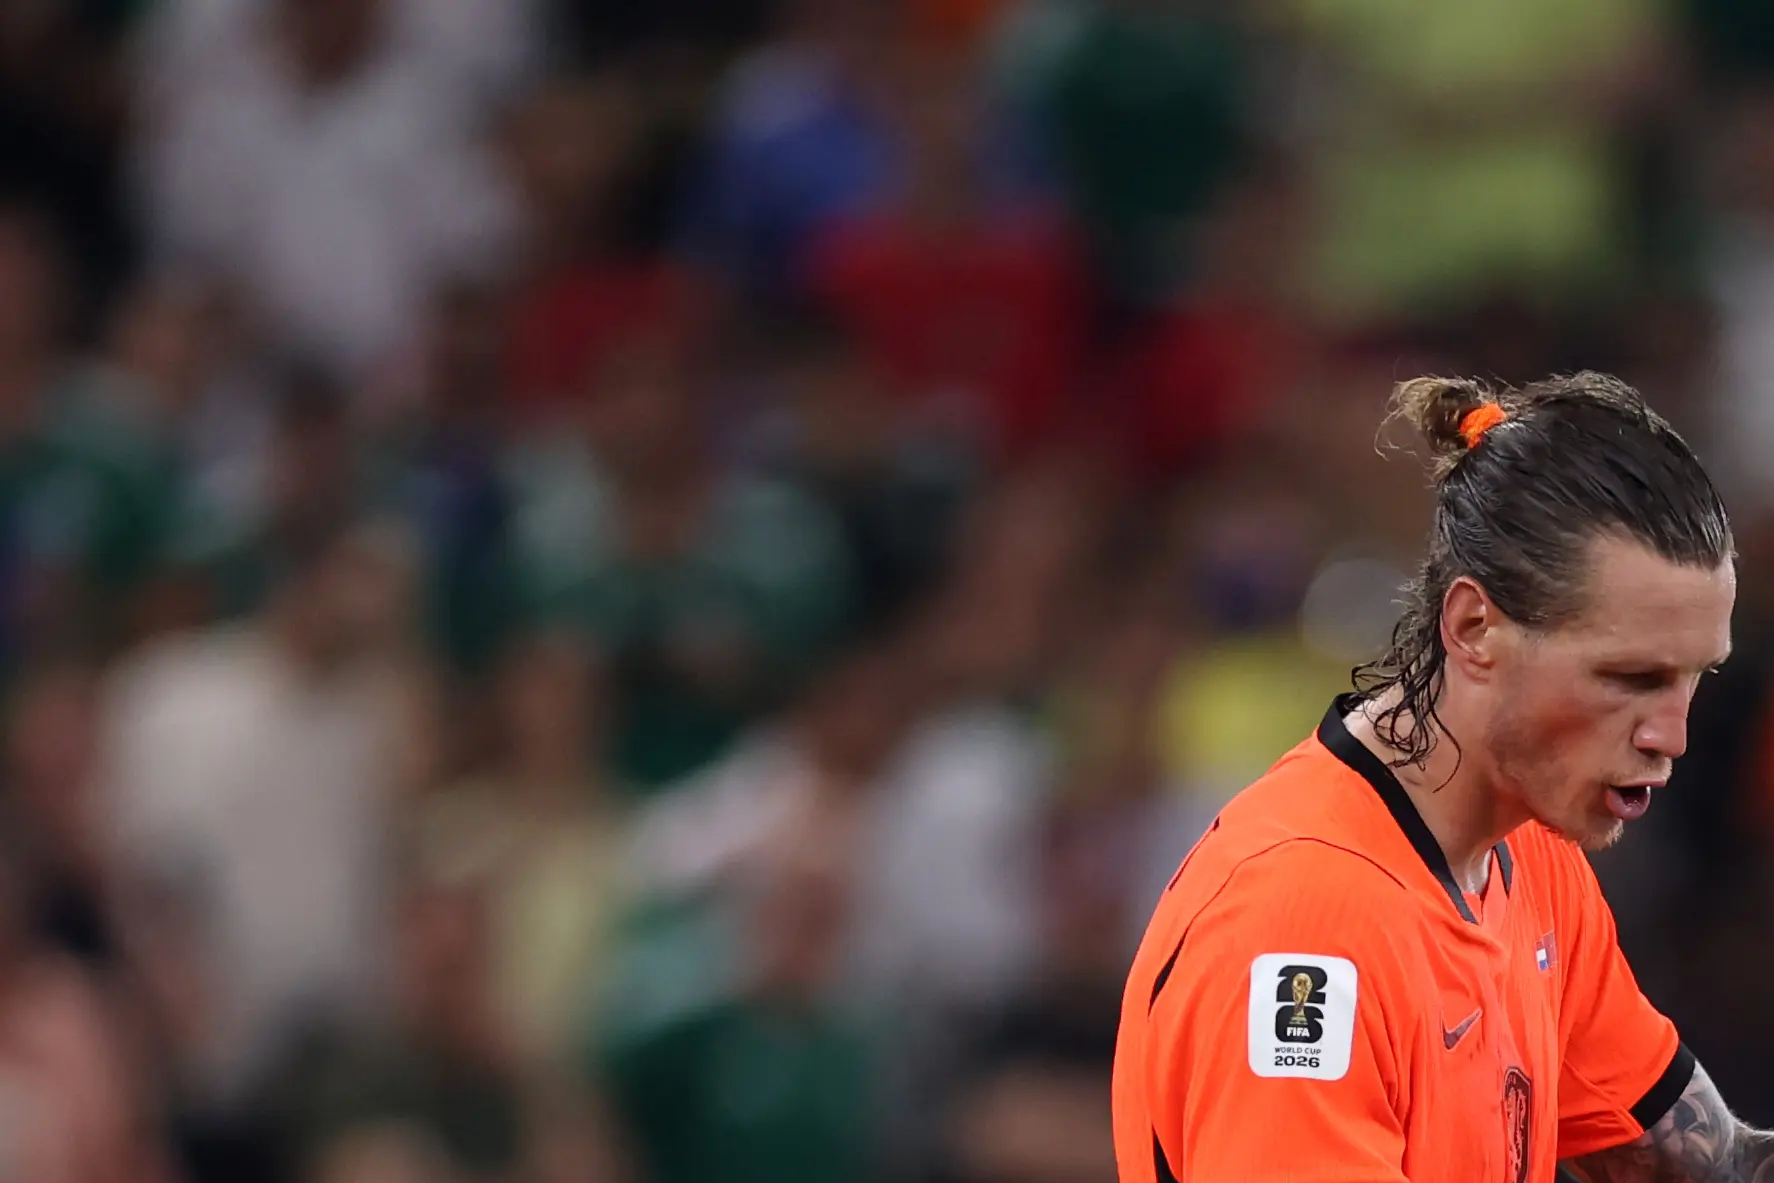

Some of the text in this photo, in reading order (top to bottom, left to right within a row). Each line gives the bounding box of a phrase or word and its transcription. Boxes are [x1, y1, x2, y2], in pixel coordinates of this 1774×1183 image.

[1287, 1027, 1310, 1037] FIFA
[1305, 1047, 1321, 1055] CUP
[1275, 1056, 1320, 1068] 2026
